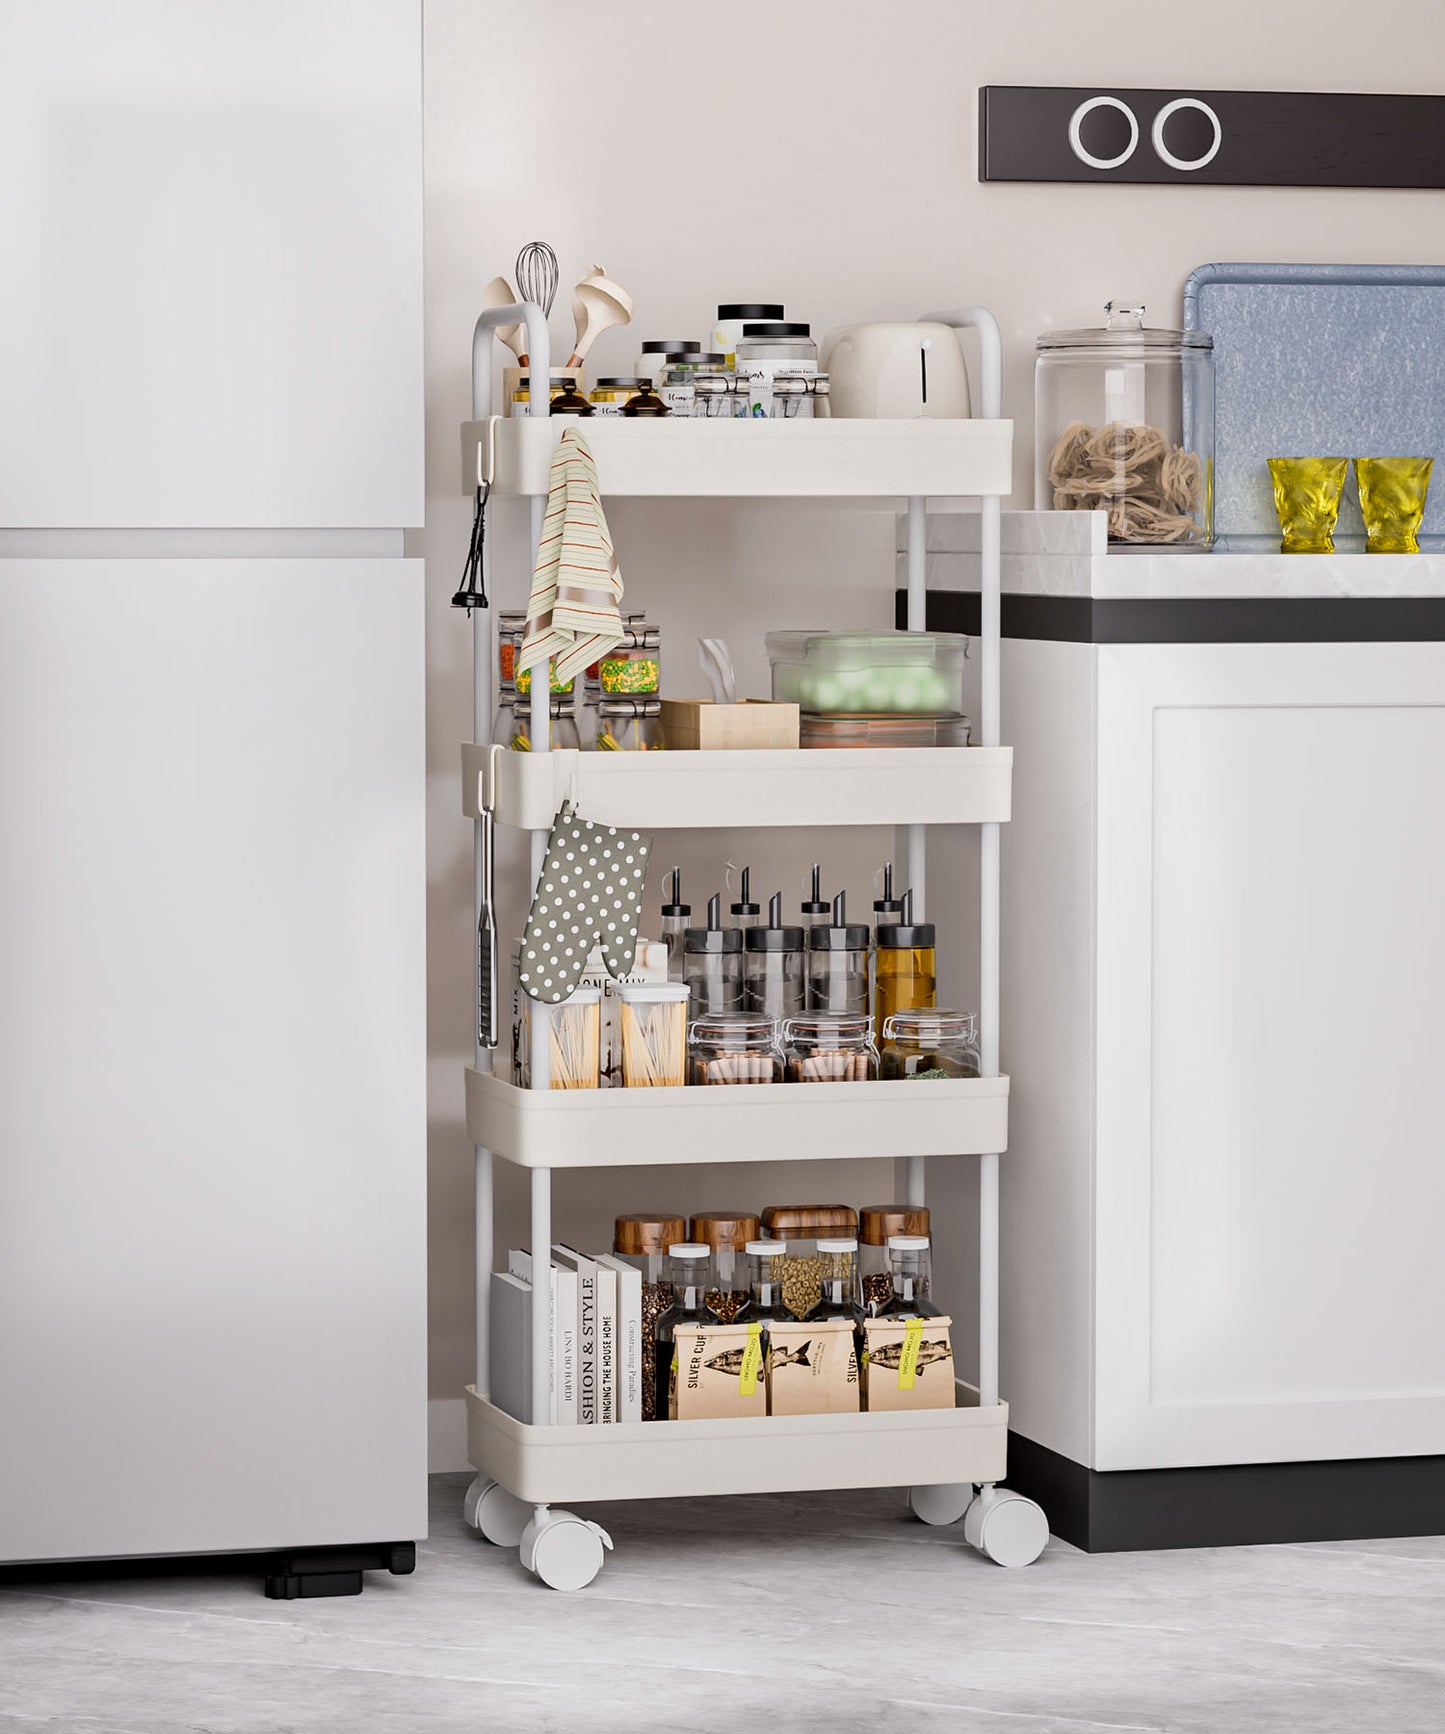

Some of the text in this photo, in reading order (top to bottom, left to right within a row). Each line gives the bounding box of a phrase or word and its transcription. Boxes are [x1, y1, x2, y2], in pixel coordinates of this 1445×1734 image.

[582, 1278, 594, 1336] STYLE
[602, 1316, 612, 1338] HOME
[582, 1341, 594, 1355] &
[602, 1340, 612, 1367] HOUSE
[564, 1330, 572, 1402] LINA BO BARDI
[602, 1369, 612, 1384] THE
[687, 1356, 702, 1389] SILVER
